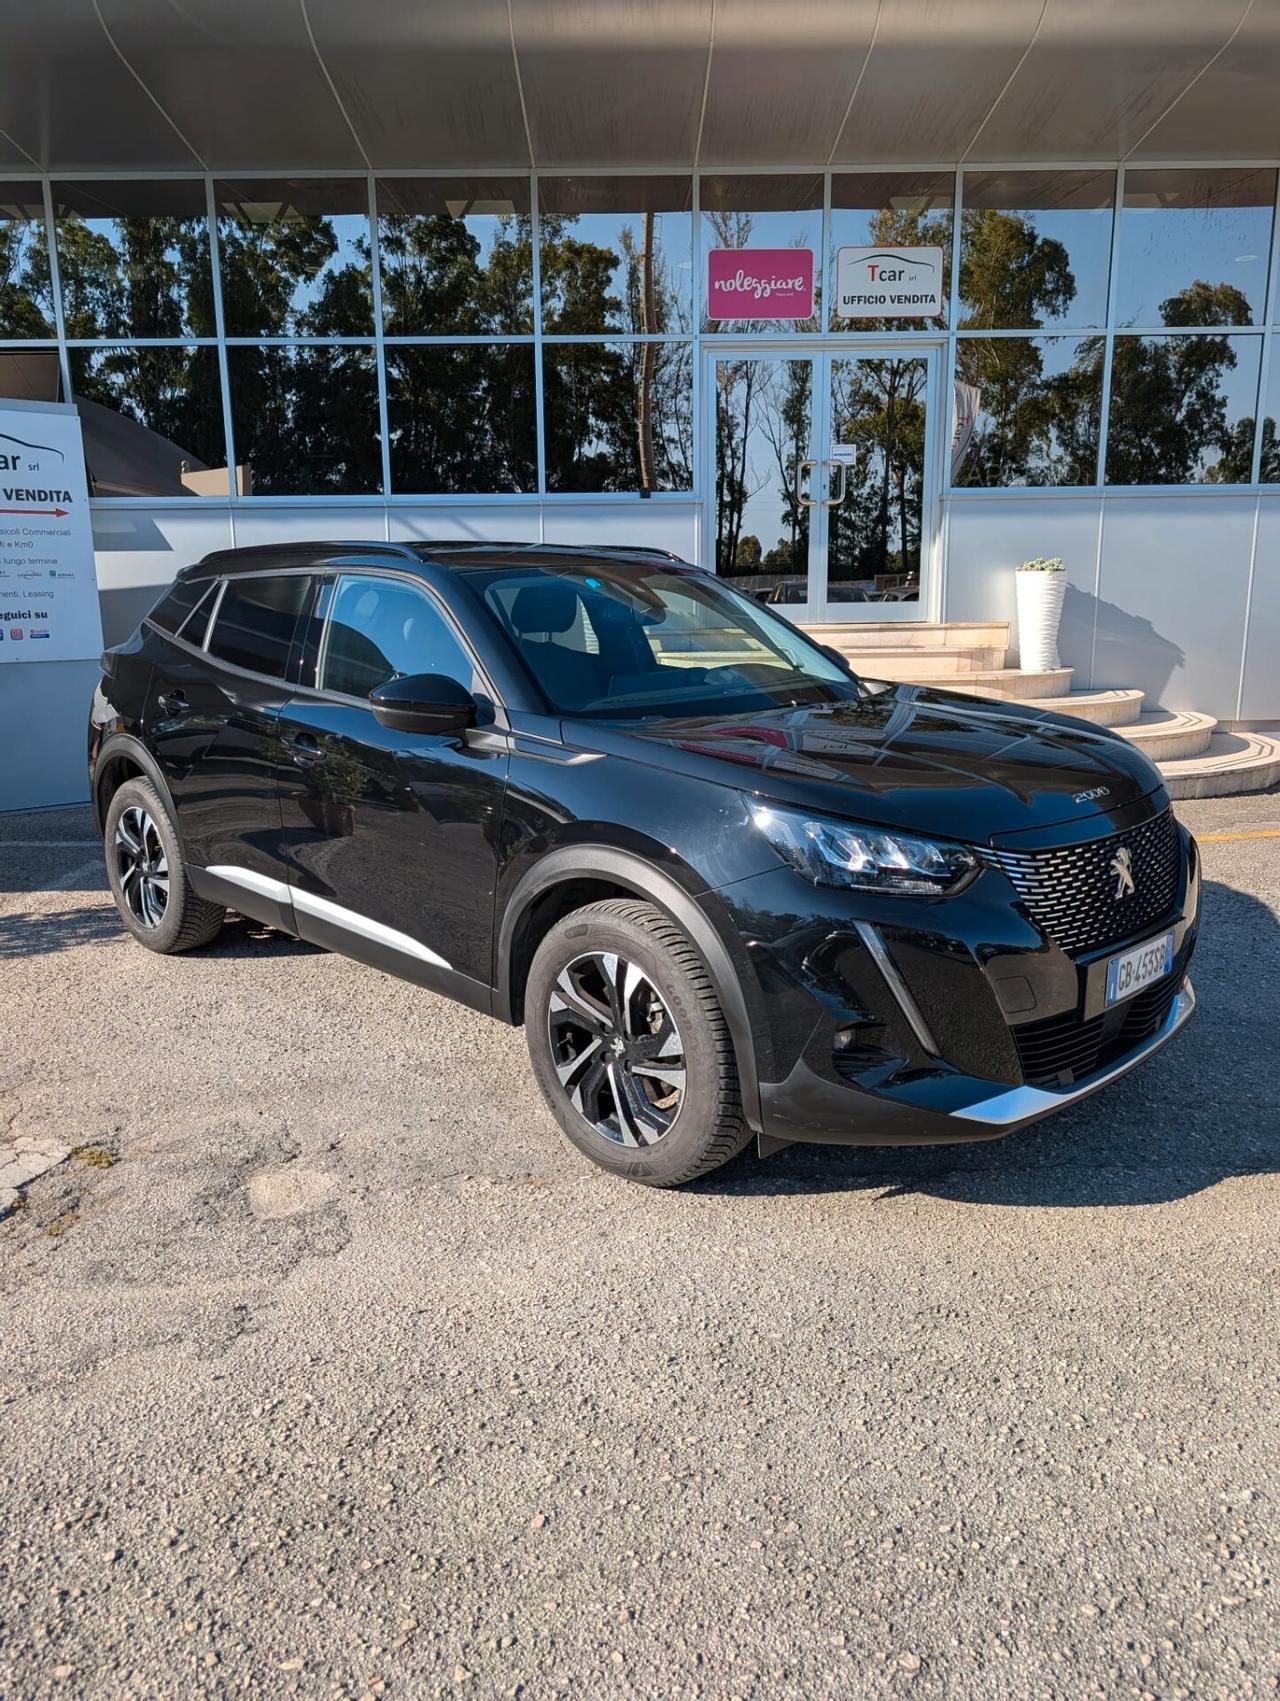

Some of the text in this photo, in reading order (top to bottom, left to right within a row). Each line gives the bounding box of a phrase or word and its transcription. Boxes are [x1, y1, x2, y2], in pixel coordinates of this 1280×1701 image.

[867, 264, 905, 281] Tcar
[842, 294, 936, 305] UFFICIO VENDITA
[27, 462, 40, 471] srl
[2, 488, 73, 503] VENDITA
[22, 528, 72, 537] Commerciali
[3, 557, 58, 566] lungo termine
[22, 590, 55, 599] Leasing
[34, 611, 48, 619] su
